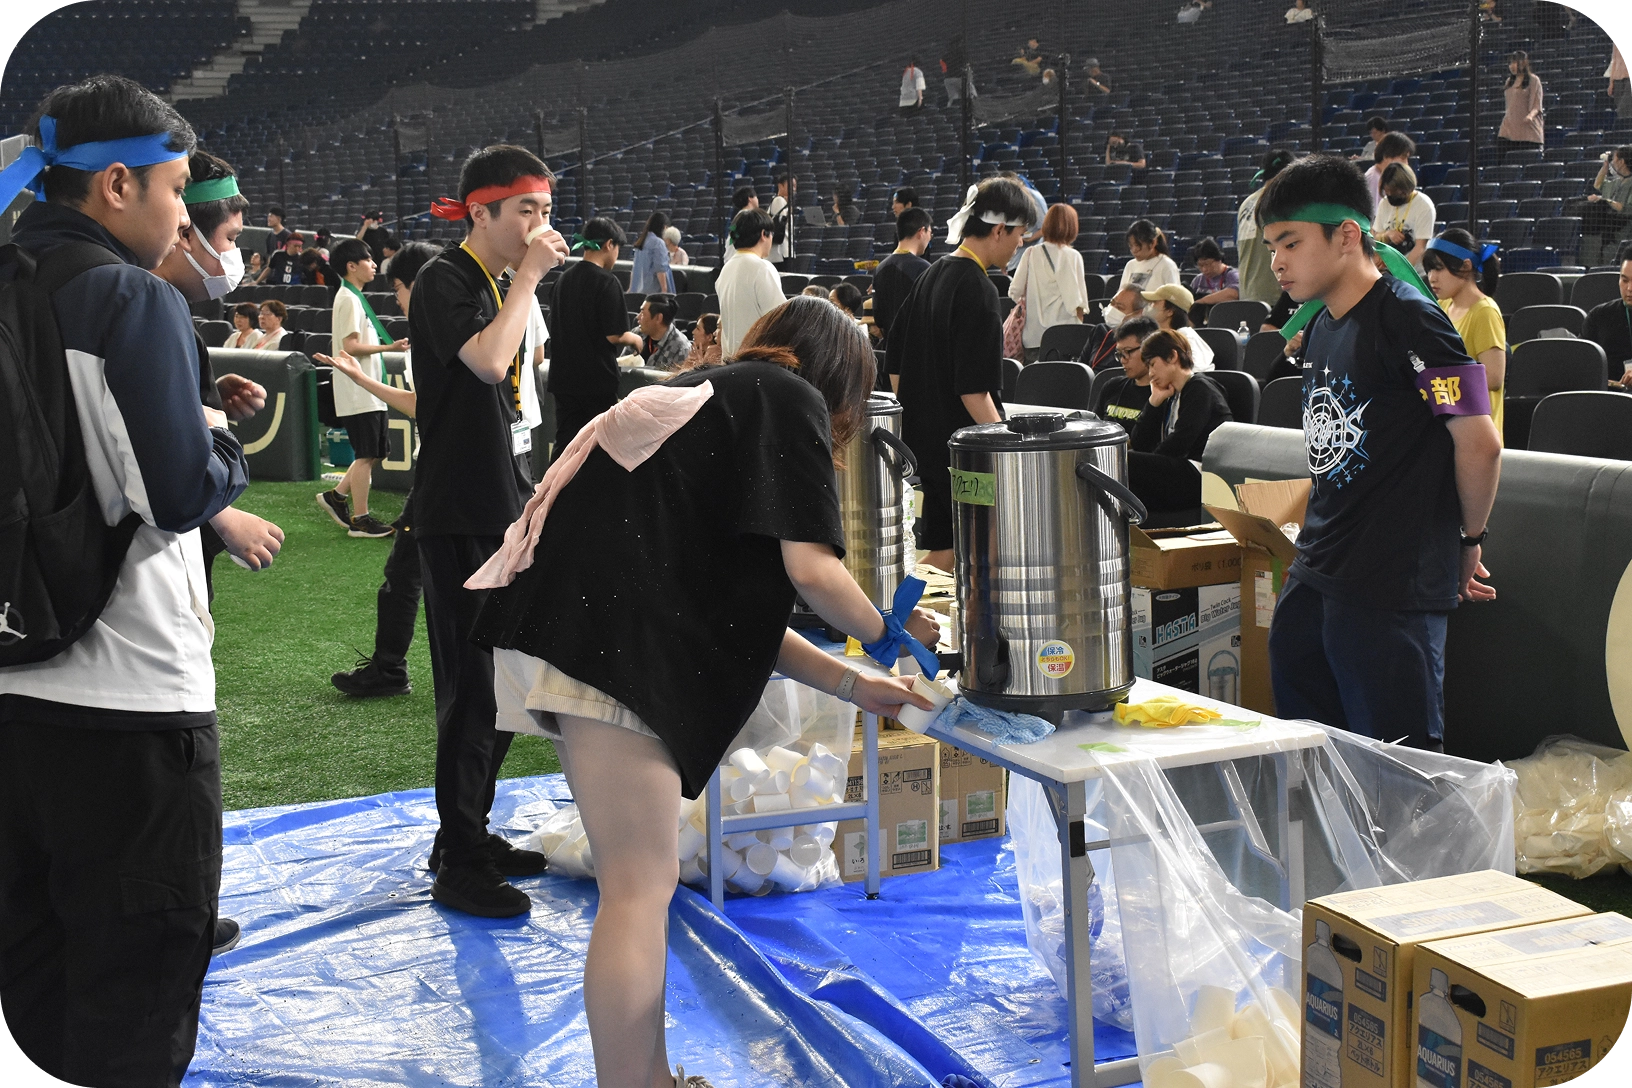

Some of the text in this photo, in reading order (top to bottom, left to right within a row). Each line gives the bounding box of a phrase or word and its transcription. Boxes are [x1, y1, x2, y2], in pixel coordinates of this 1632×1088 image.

[1156, 612, 1196, 644] HASTA
[1047, 646, 1064, 655] 保冷
[1048, 663, 1065, 672] 保温
[1306, 992, 1338, 1020] AQUARIUS
[1353, 1013, 1379, 1034] 054565
[1348, 1023, 1383, 1048] アクエリアス
[1350, 1049, 1380, 1071] ペットボトル
[1417, 1044, 1456, 1077] AQUARIUS
[1544, 1048, 1582, 1063] 054565
[1537, 1060, 1587, 1078] アクエリアス
